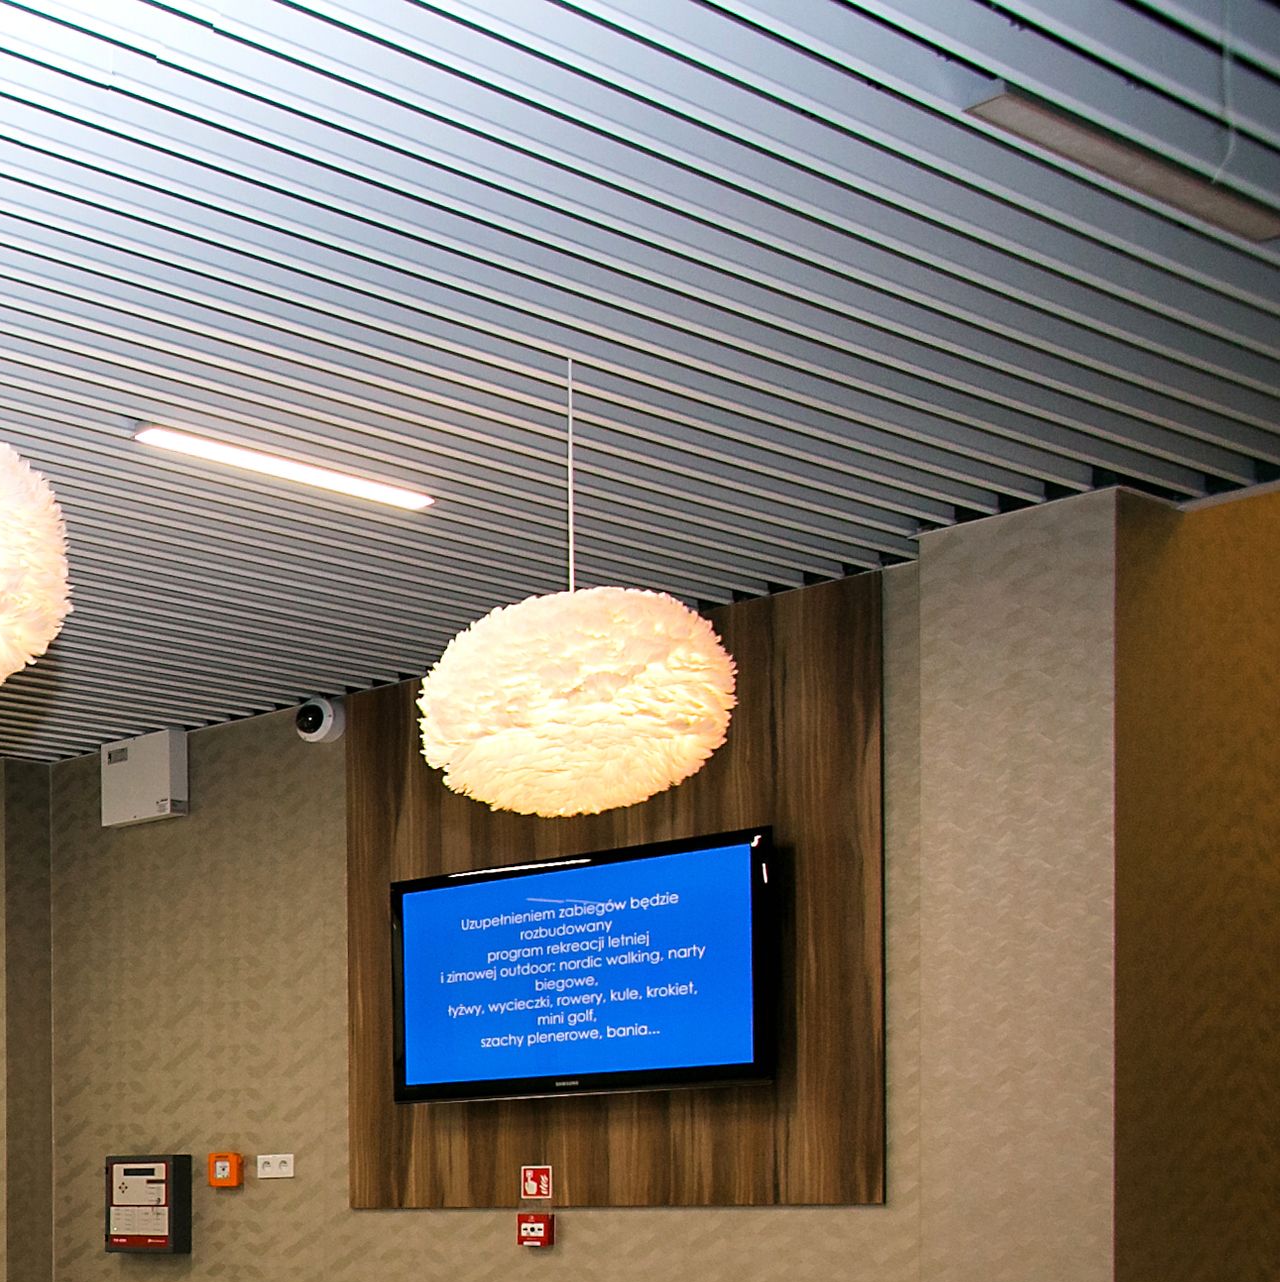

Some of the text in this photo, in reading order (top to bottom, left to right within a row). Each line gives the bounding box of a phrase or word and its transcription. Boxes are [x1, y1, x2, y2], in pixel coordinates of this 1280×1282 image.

[461, 891, 680, 931] Uzupełnieniem zabiegów będzie
[520, 920, 613, 941] rozbudowany
[487, 931, 650, 964] program rekreacji letniej
[440, 943, 706, 984] i zimowej outdoor: nordic walking, narty
[534, 975, 598, 993] biegowe,
[447, 981, 698, 1019] łyżwy, wycieczki, rowery, kule, krokiet,
[537, 1008, 597, 1027] mini golf,
[480, 1023, 661, 1048] szachy plenerowe, bania...
